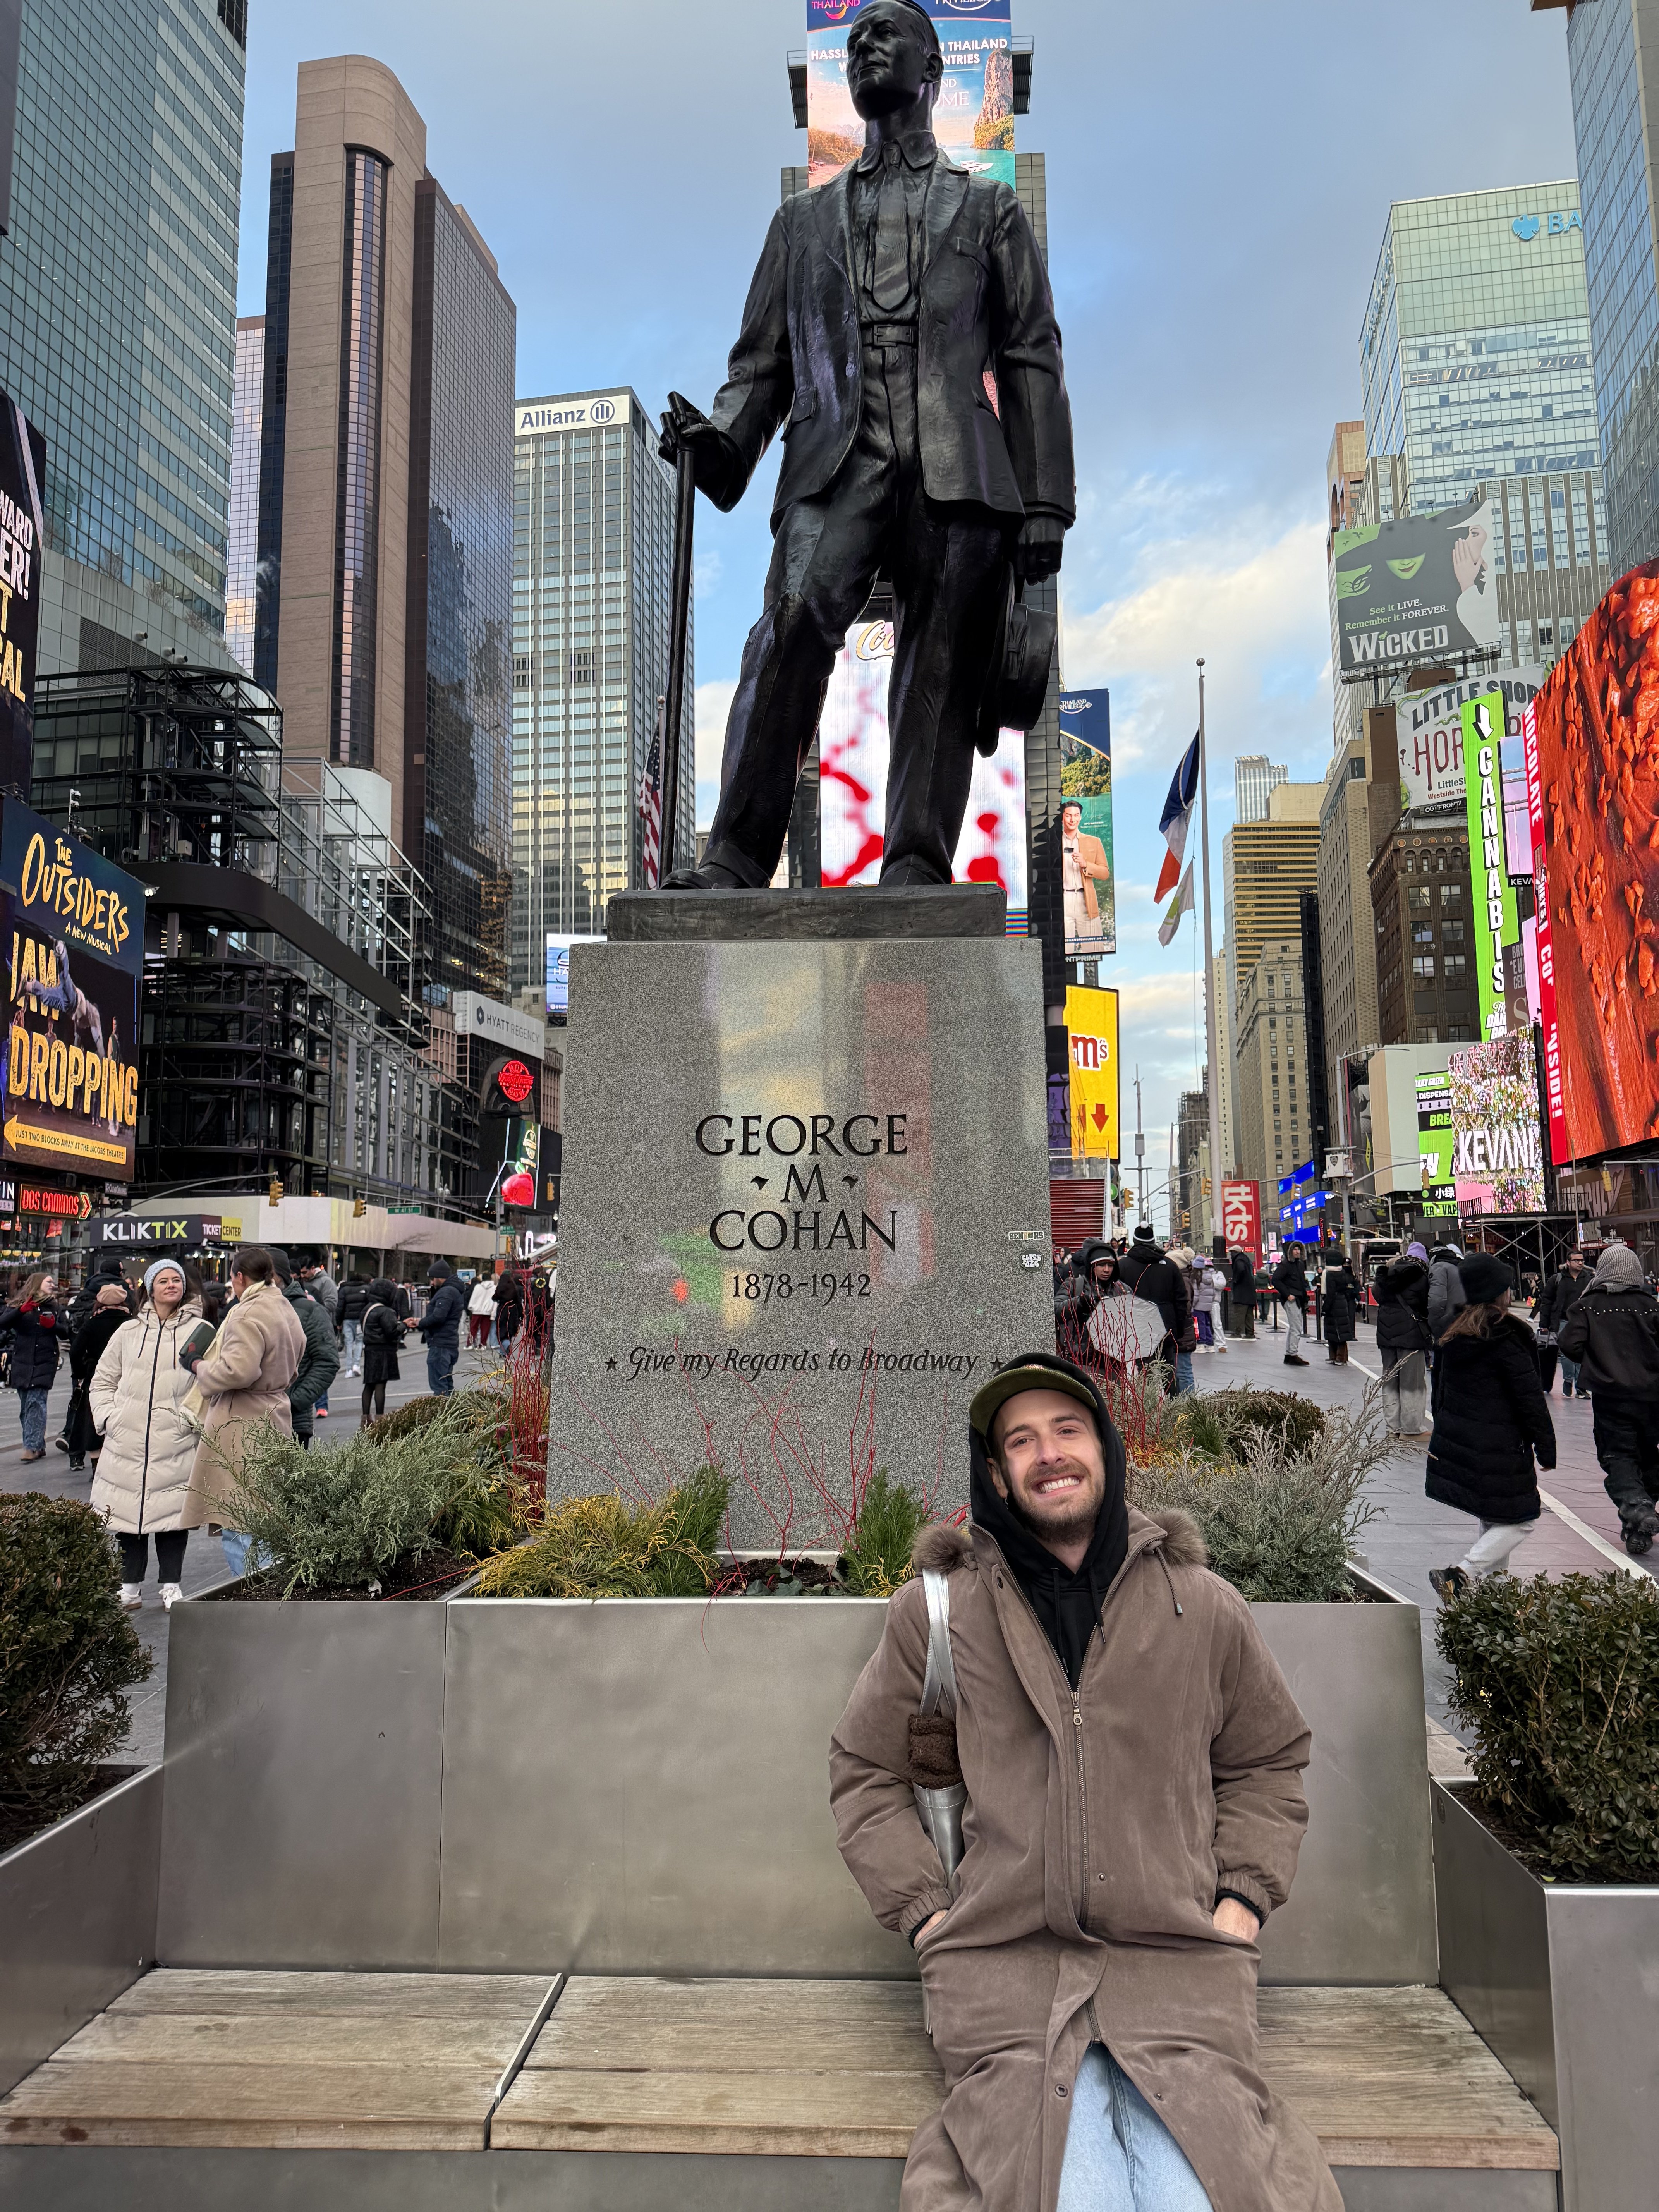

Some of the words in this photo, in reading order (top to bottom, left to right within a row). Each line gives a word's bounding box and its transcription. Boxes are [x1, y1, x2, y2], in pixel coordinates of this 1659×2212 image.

[812, 0, 860, 9] THAILAND
[811, 49, 848, 60] HASSL
[948, 39, 1008, 52] THAILAND
[520, 409, 586, 429] Allianz
[1345, 616, 1391, 630] Remember
[1402, 605, 1449, 620] FOREVER.
[1397, 599, 1422, 610] LIVE.
[1412, 682, 1480, 732] LITTLE
[1413, 726, 1465, 791] HOR
[1428, 790, 1455, 800] Westside
[55, 837, 72, 866] THE
[1479, 746, 1504, 992] CANNABIS
[22, 833, 130, 953] OUTSIDERS
[65, 922, 71, 935] A
[72, 925, 86, 940] NEW
[86, 933, 112, 955] MUSICAL
[487, 1013, 509, 1032] HYATT
[511, 1024, 540, 1043] REGENCY
[9, 1025, 138, 1126] DROPPING
[15, 1129, 27, 1139] JUST
[29, 1132, 40, 1142] TWO
[41, 1134, 60, 1146] BLOCKS
[61, 1139, 74, 1148] AWAY
[90, 1145, 105, 1155] JACOBS
[106, 1149, 124, 1159] THEATRE
[696, 1114, 908, 1156] GEORGE
[780, 1164, 830, 1202] M
[22, 1189, 41, 1211] DOS
[1224, 1184, 1253, 1242] tkts
[103, 1221, 188, 1241] KLIKTIX
[202, 1223, 221, 1235] TICKET
[222, 1226, 242, 1237] CENTER
[709, 1209, 898, 1252] COHAN
[732, 1273, 871, 1306] 1878-1942
[627, 1346, 675, 1381] Give
[682, 1352, 717, 1381] my
[724, 1348, 819, 1382] Regards
[828, 1349, 851, 1371] to
[859, 1346, 979, 1380] Broadway
